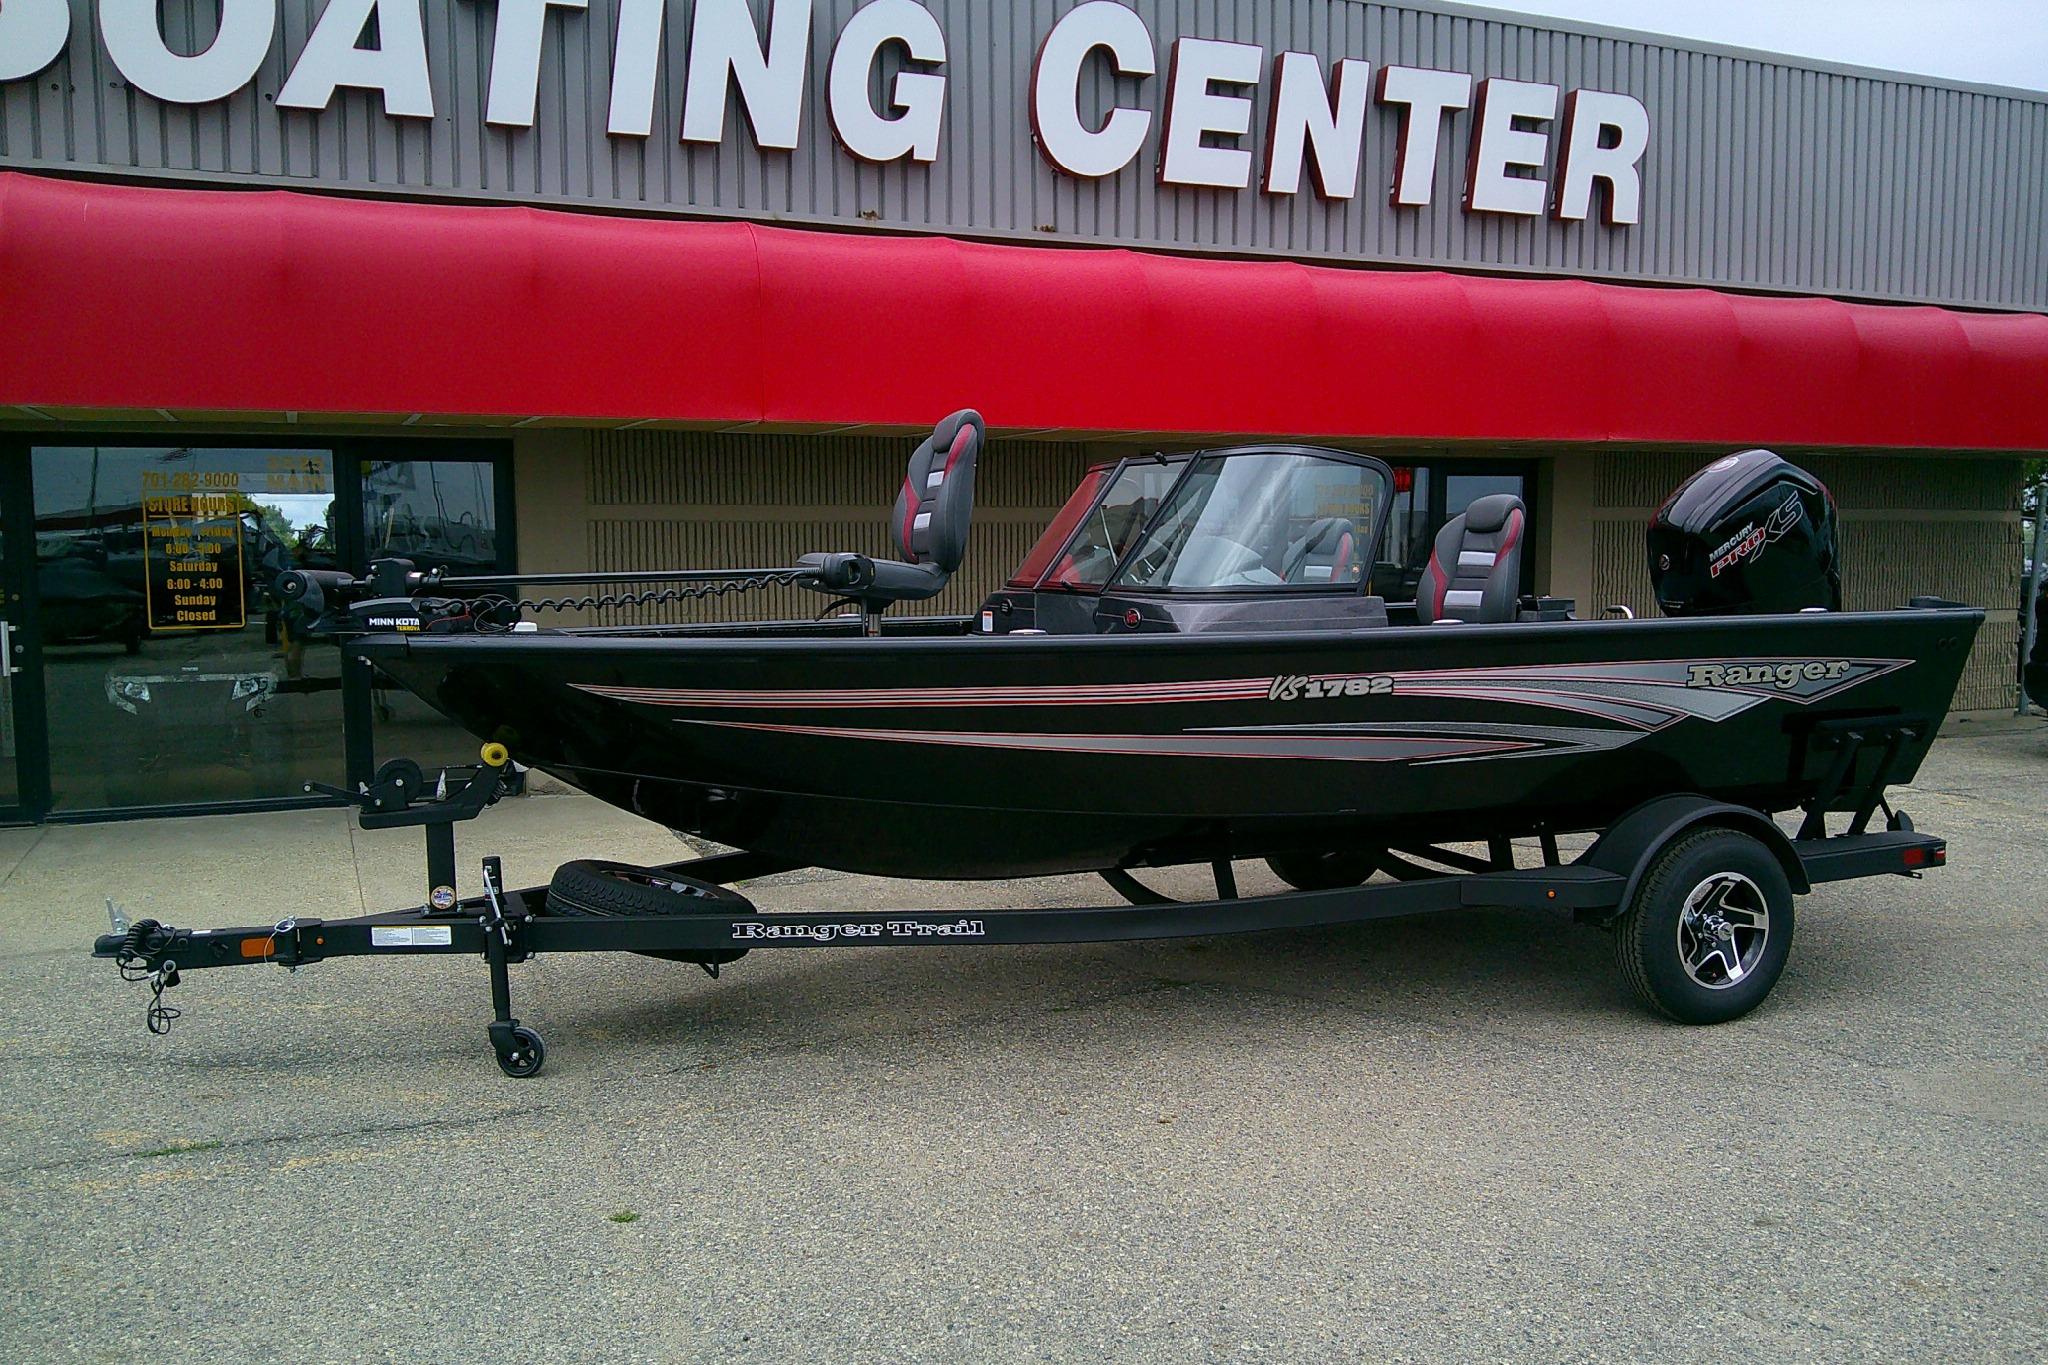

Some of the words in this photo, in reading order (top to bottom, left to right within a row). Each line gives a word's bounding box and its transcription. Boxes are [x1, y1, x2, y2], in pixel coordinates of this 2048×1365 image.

[0, 0, 947, 163] OATING
[1031, 0, 1651, 227] CENTER
[148, 496, 188, 512] STORE
[191, 496, 234, 512] HOURS
[1709, 521, 1754, 562] MERCURY
[1711, 526, 1766, 579] PRO
[169, 561, 218, 573] Saturday
[167, 579, 191, 590] 8:00
[200, 578, 223, 589] 4:00
[174, 594, 216, 606] Sunday
[176, 610, 216, 621] Closed
[369, 618, 394, 626] MINN
[395, 618, 420, 626] KOTA
[1687, 660, 1850, 690] Ranger
[732, 922, 883, 940] Ranger
[886, 919, 985, 937] Trail
